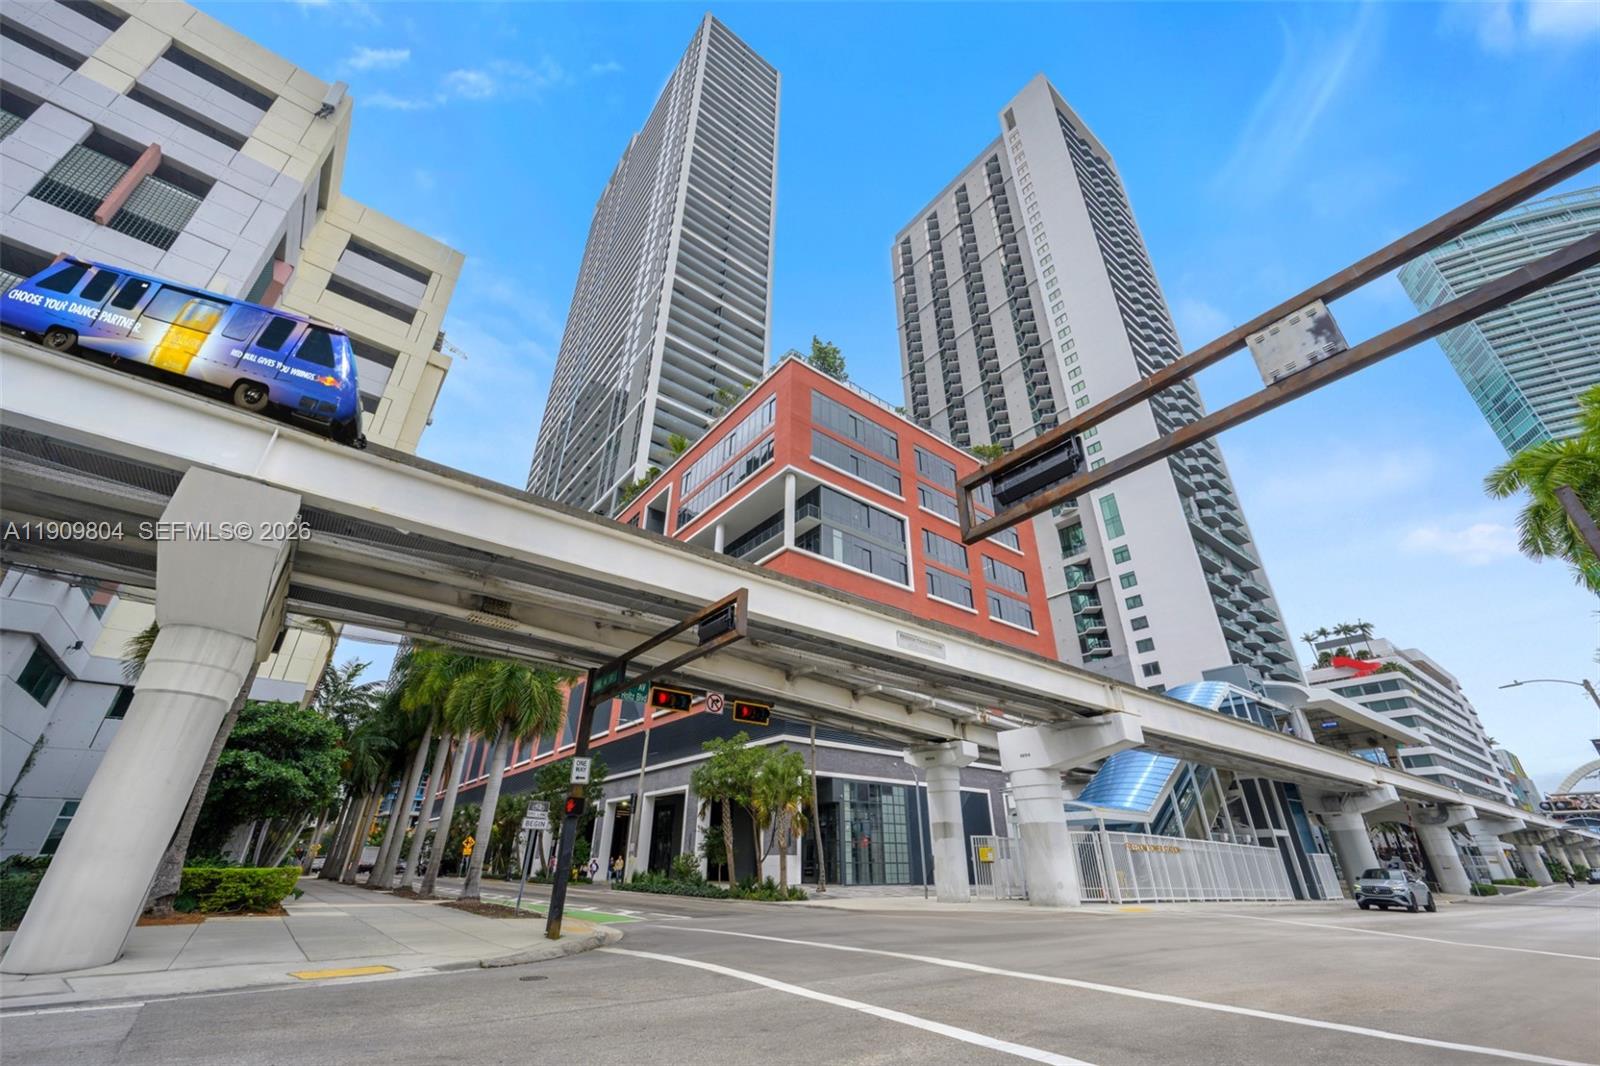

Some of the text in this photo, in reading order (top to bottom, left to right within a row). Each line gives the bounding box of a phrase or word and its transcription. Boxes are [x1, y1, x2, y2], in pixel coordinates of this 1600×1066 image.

[8, 289, 43, 306] CHOOSE
[68, 303, 100, 320] DANCE
[99, 312, 142, 333] PARTNER
[230, 348, 243, 359] RED
[243, 353, 257, 363] BULL
[257, 356, 275, 368] GIVES
[276, 361, 290, 374] YOU
[525, 820, 546, 828] BEGIN
